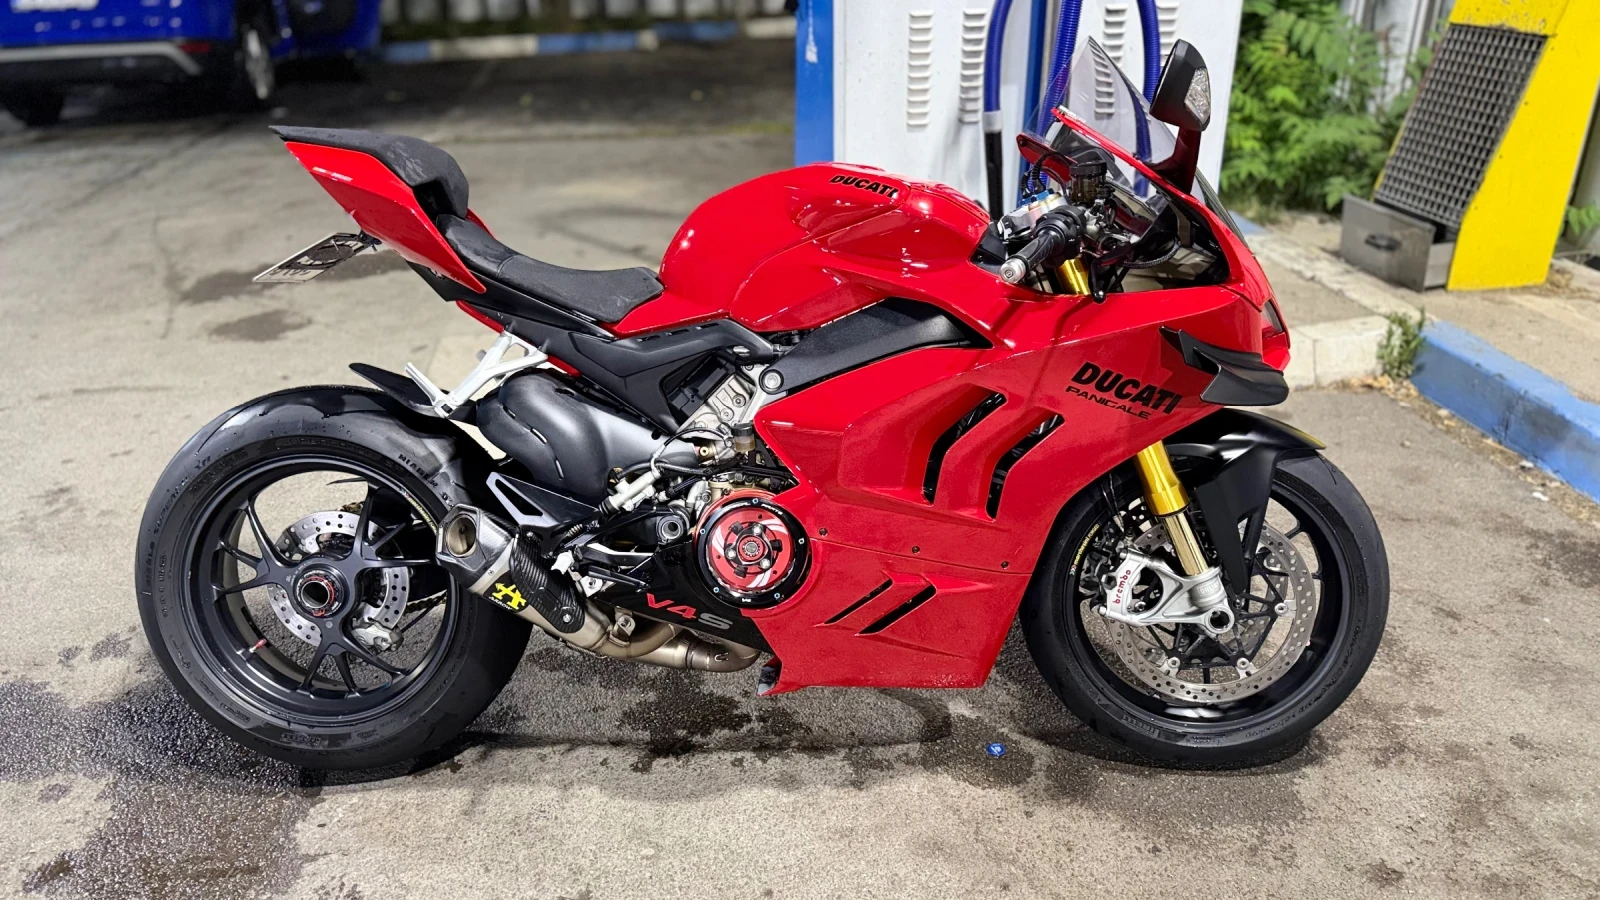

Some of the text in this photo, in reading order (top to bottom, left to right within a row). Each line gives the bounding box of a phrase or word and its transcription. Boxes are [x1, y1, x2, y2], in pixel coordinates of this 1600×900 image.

[829, 174, 899, 199] DUCATI
[1071, 361, 1183, 415] DUCATI
[1112, 569, 1132, 605] brembo
